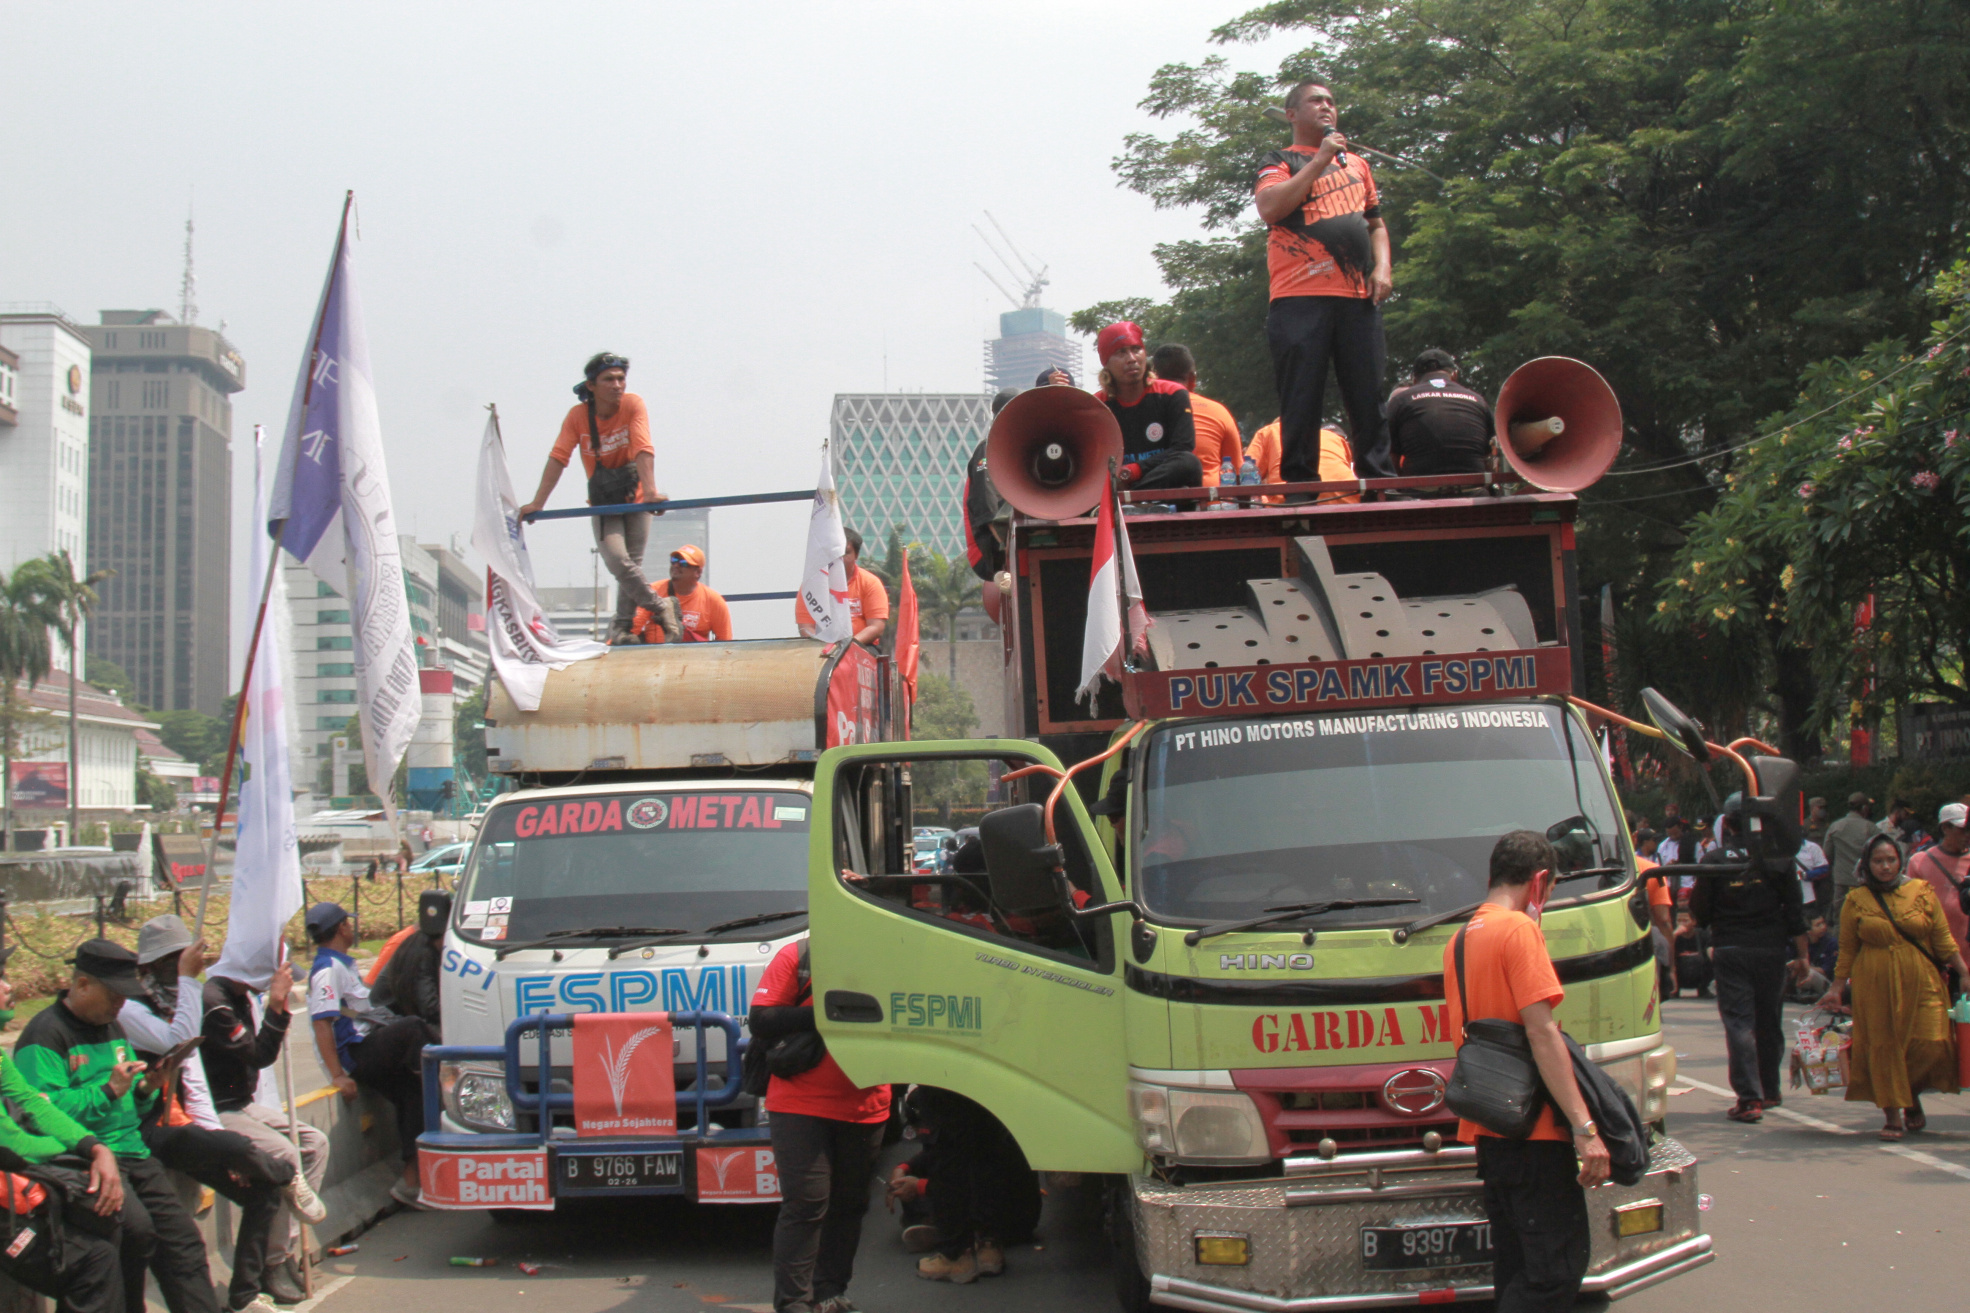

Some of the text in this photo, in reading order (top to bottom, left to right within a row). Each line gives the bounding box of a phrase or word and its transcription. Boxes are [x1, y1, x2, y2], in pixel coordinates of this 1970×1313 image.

[1412, 391, 1477, 402] LASKAR NASIONAL
[805, 591, 823, 614] DPP
[1169, 655, 1538, 711] PUK SPAMK FSPMI
[1175, 711, 1549, 751] PT HINO MOTORS MANUFACTURING INDONESIA
[515, 801, 623, 838] GARDA
[669, 796, 783, 829] METAL
[975, 952, 1115, 998] TURBO INTERCOOLER
[1220, 954, 1314, 970] HINO
[515, 965, 747, 1018] FSPMI
[890, 992, 982, 1030] FSPMI
[1252, 1007, 1405, 1054] GARDA
[583, 1117, 673, 1131] Negara Sejahtera
[458, 1157, 543, 1179] Partai
[568, 1156, 677, 1178] B 9766 FAW
[459, 1180, 545, 1202] Buruh
[1364, 1231, 1378, 1257] B
[1402, 1227, 1458, 1256] 9397
